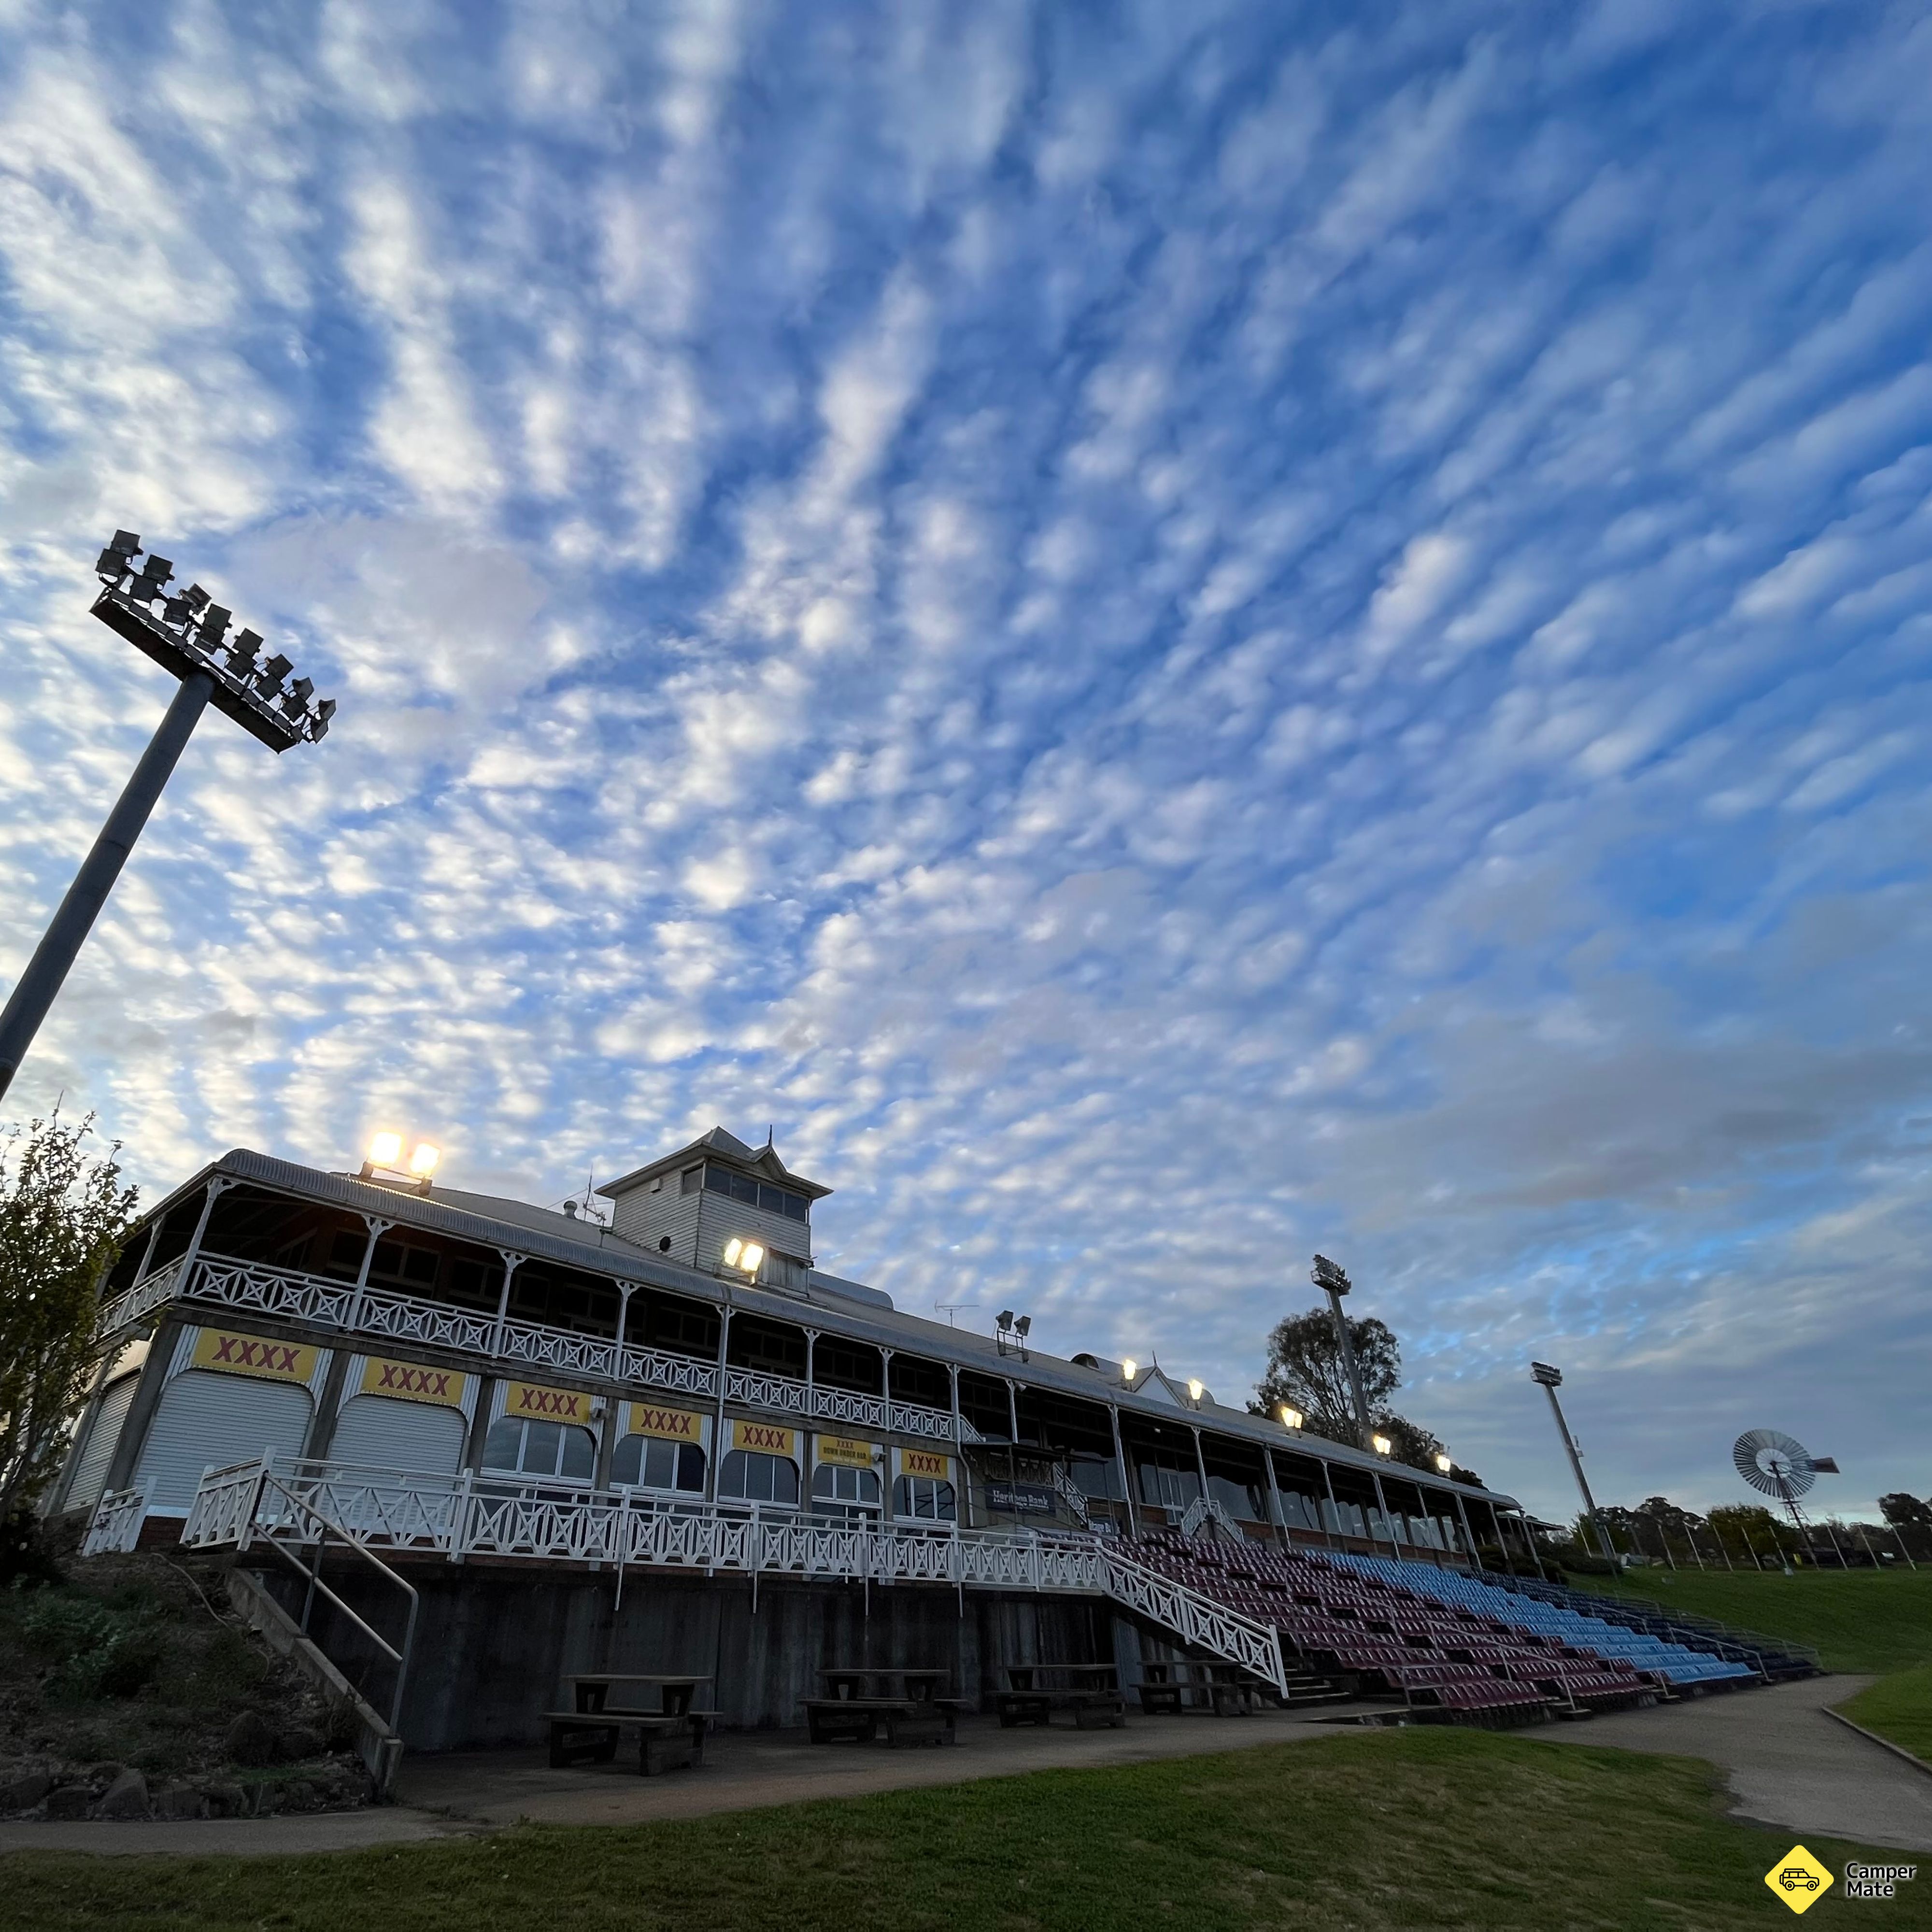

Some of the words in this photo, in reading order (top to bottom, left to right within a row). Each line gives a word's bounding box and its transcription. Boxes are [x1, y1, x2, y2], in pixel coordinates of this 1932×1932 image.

[212, 1336, 300, 1373] XXXX
[377, 1364, 451, 1396] XXXX
[519, 1388, 579, 1417] XXXX
[641, 1409, 691, 1435] XXXX
[743, 1426, 786, 1449] XXXX
[837, 1439, 853, 1449] XXXX
[839, 1449, 856, 1458] UNDER
[909, 1453, 941, 1473] XXXX
[1028, 1494, 1049, 1508] Bank
